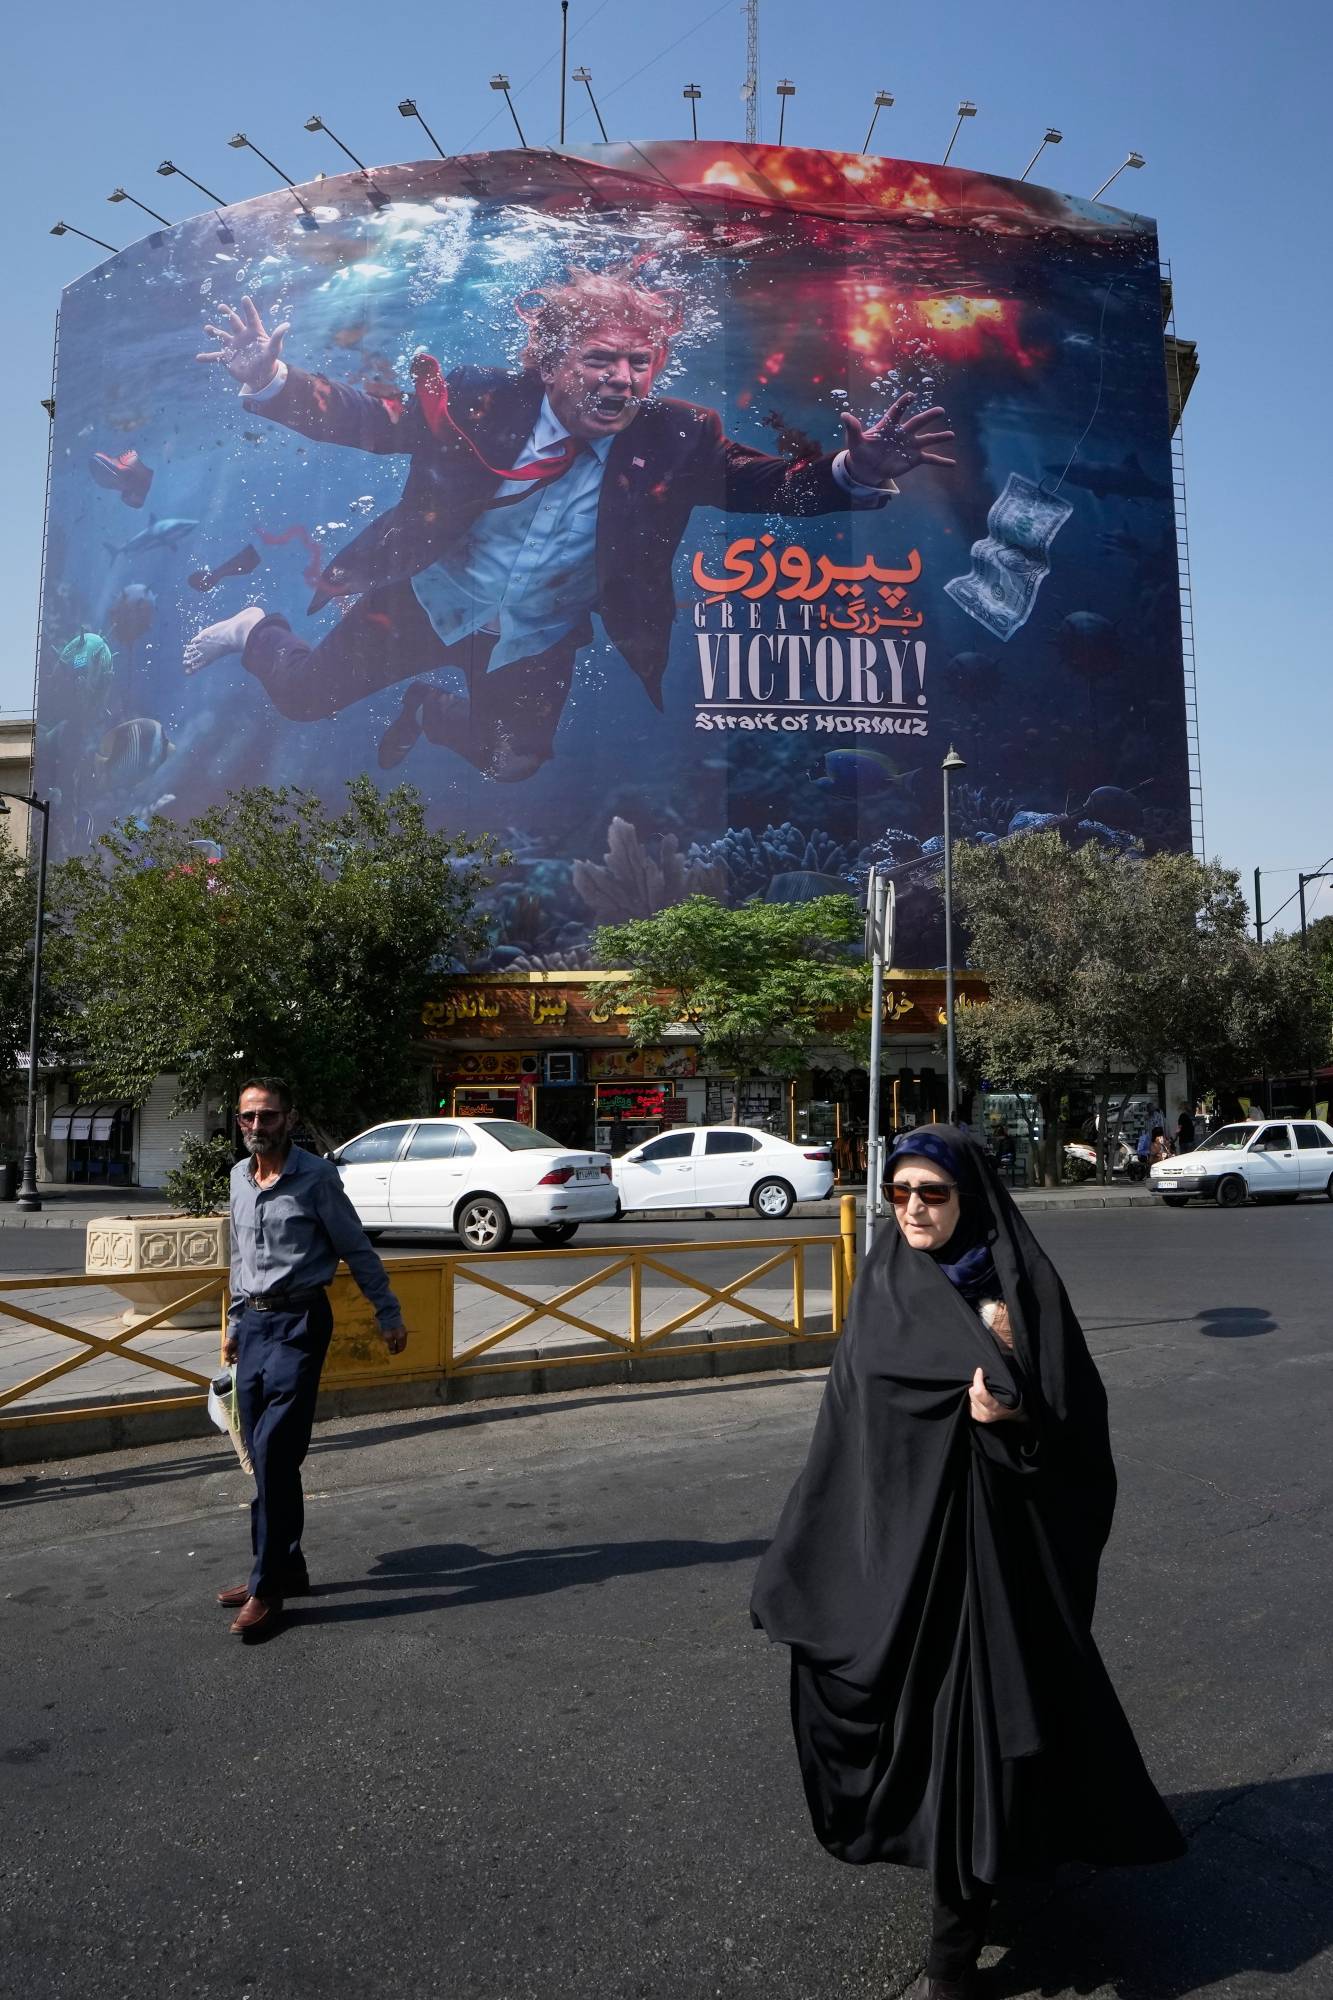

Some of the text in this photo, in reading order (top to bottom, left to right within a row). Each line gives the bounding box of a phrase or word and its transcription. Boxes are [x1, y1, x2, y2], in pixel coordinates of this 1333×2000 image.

[694, 602, 813, 630] GREAT
[694, 633, 927, 706] VICTORY!
[695, 712, 779, 731] Strait
[529, 991, 568, 1026] پیتزا
